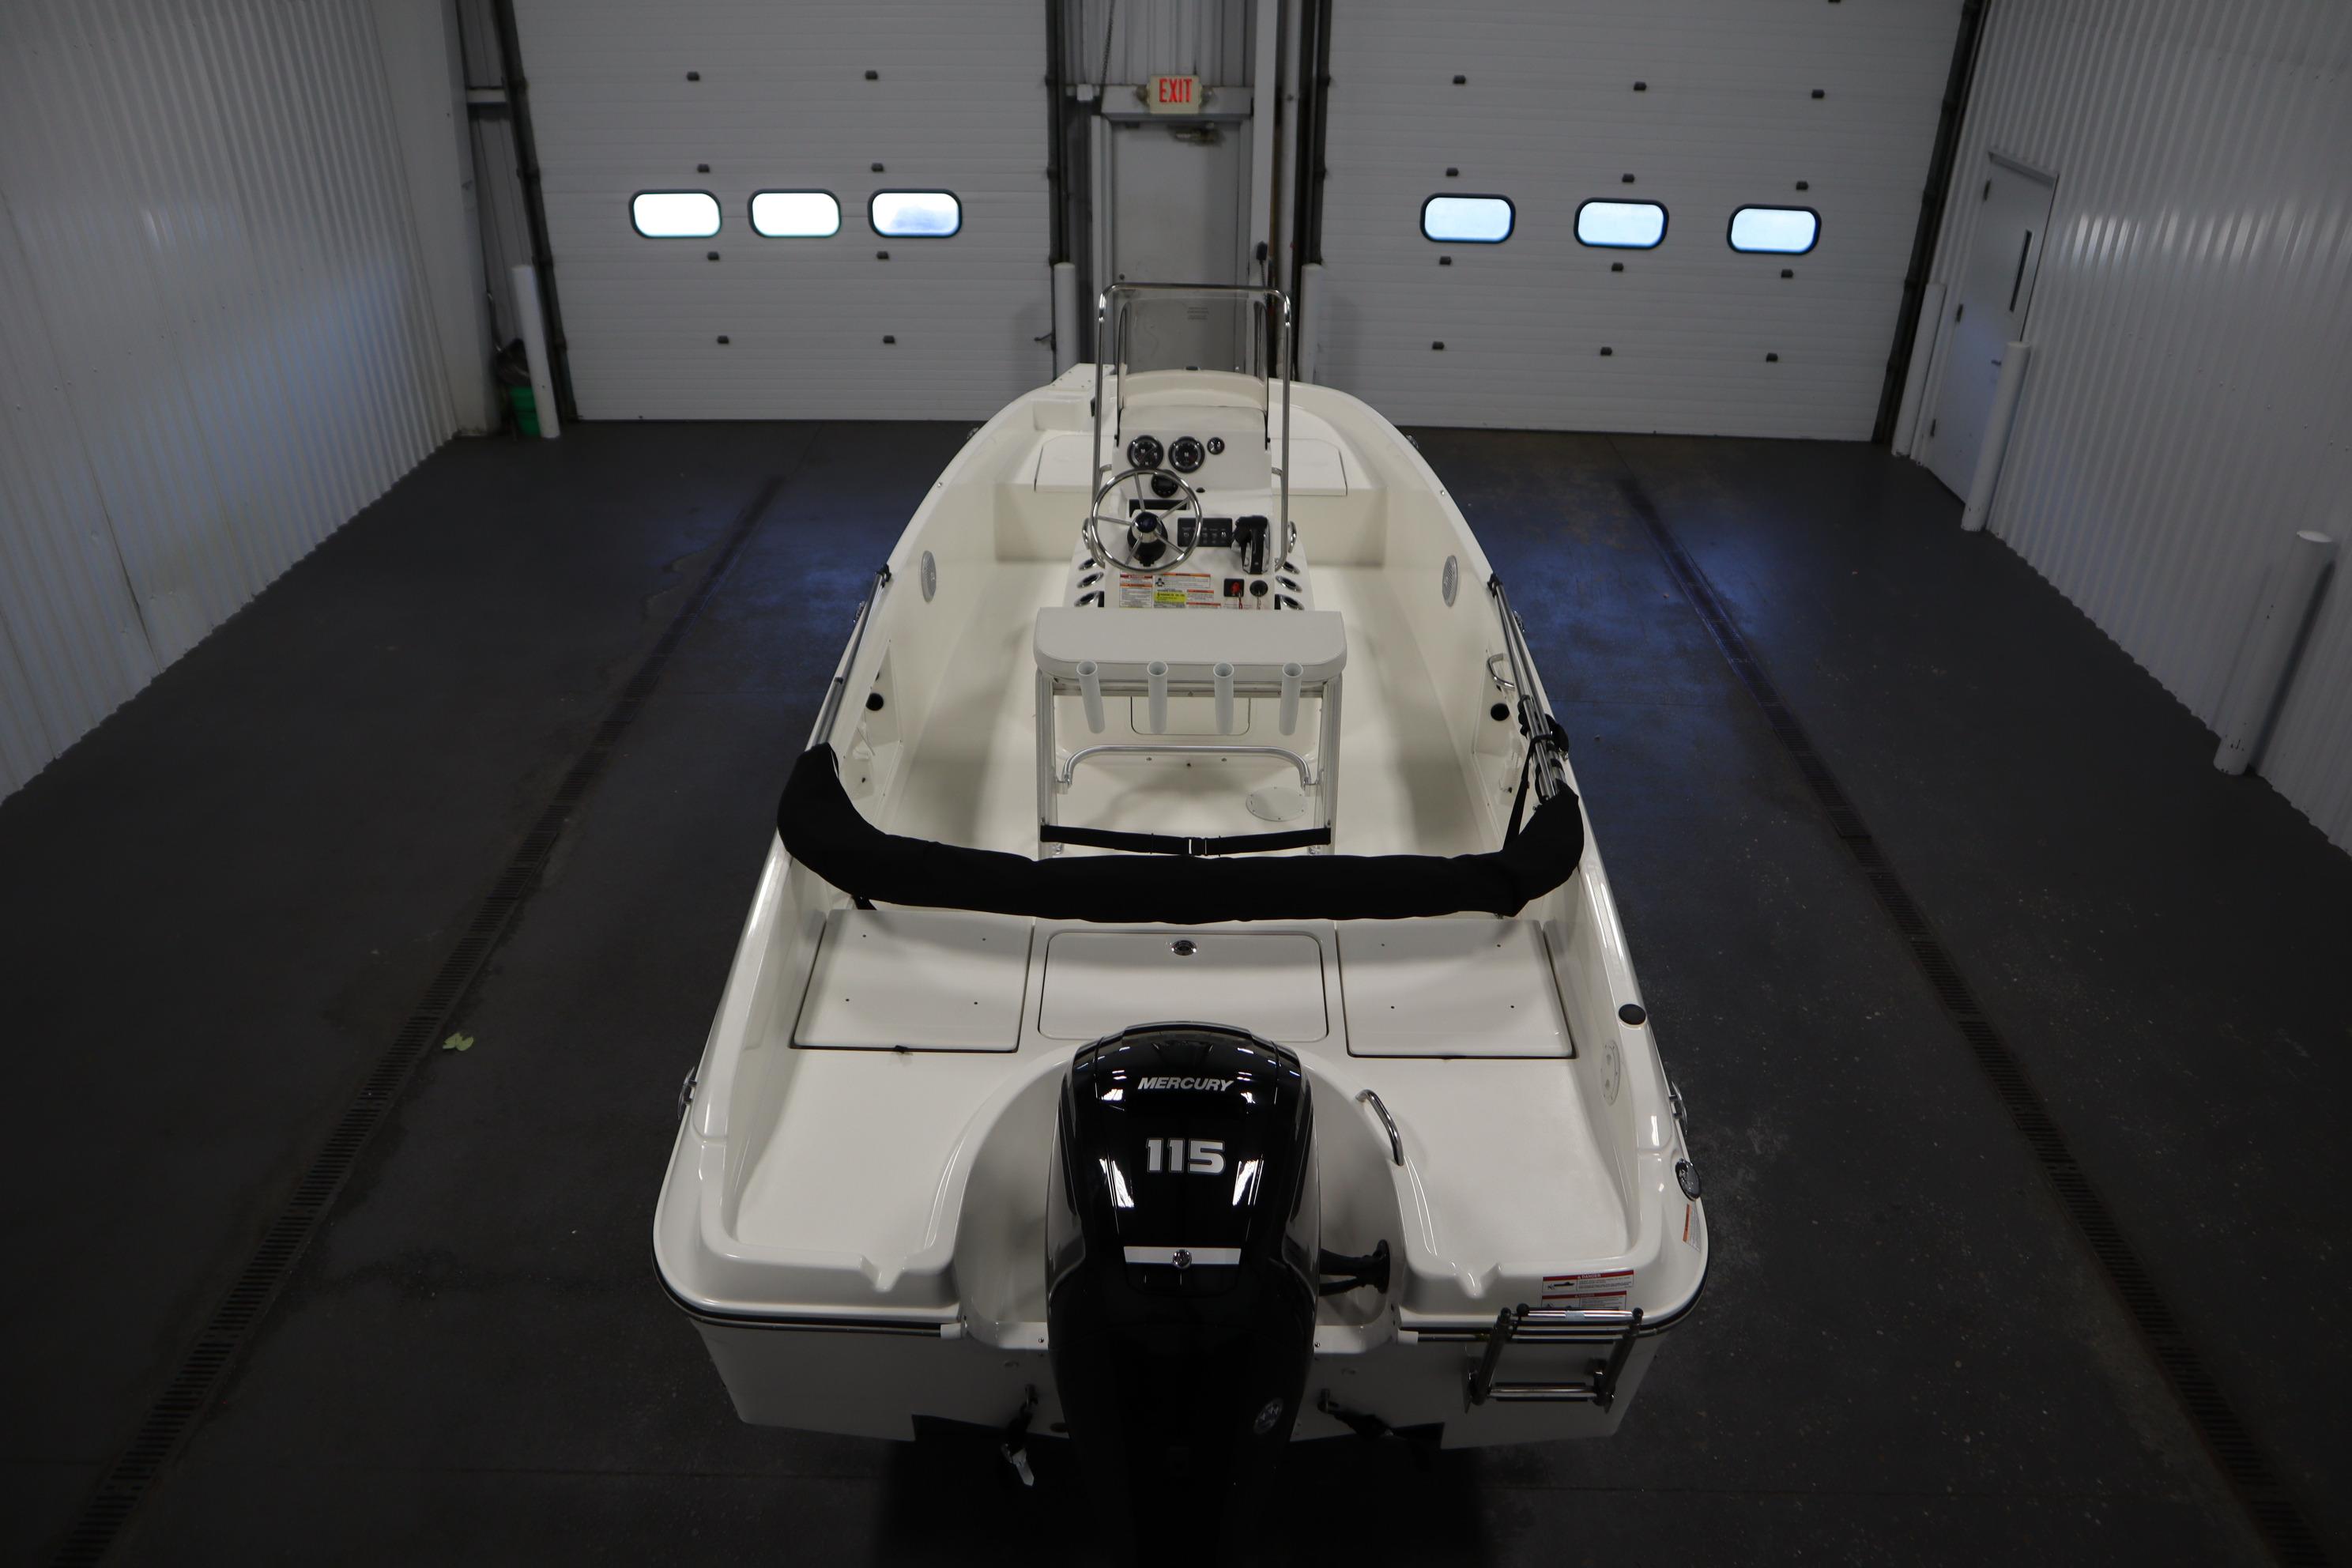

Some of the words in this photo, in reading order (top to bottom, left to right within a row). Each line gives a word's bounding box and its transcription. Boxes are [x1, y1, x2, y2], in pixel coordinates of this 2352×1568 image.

[1159, 77, 1193, 103] EXIT
[1137, 1076, 1234, 1091] MERCURY
[1146, 1138, 1226, 1176] 115
